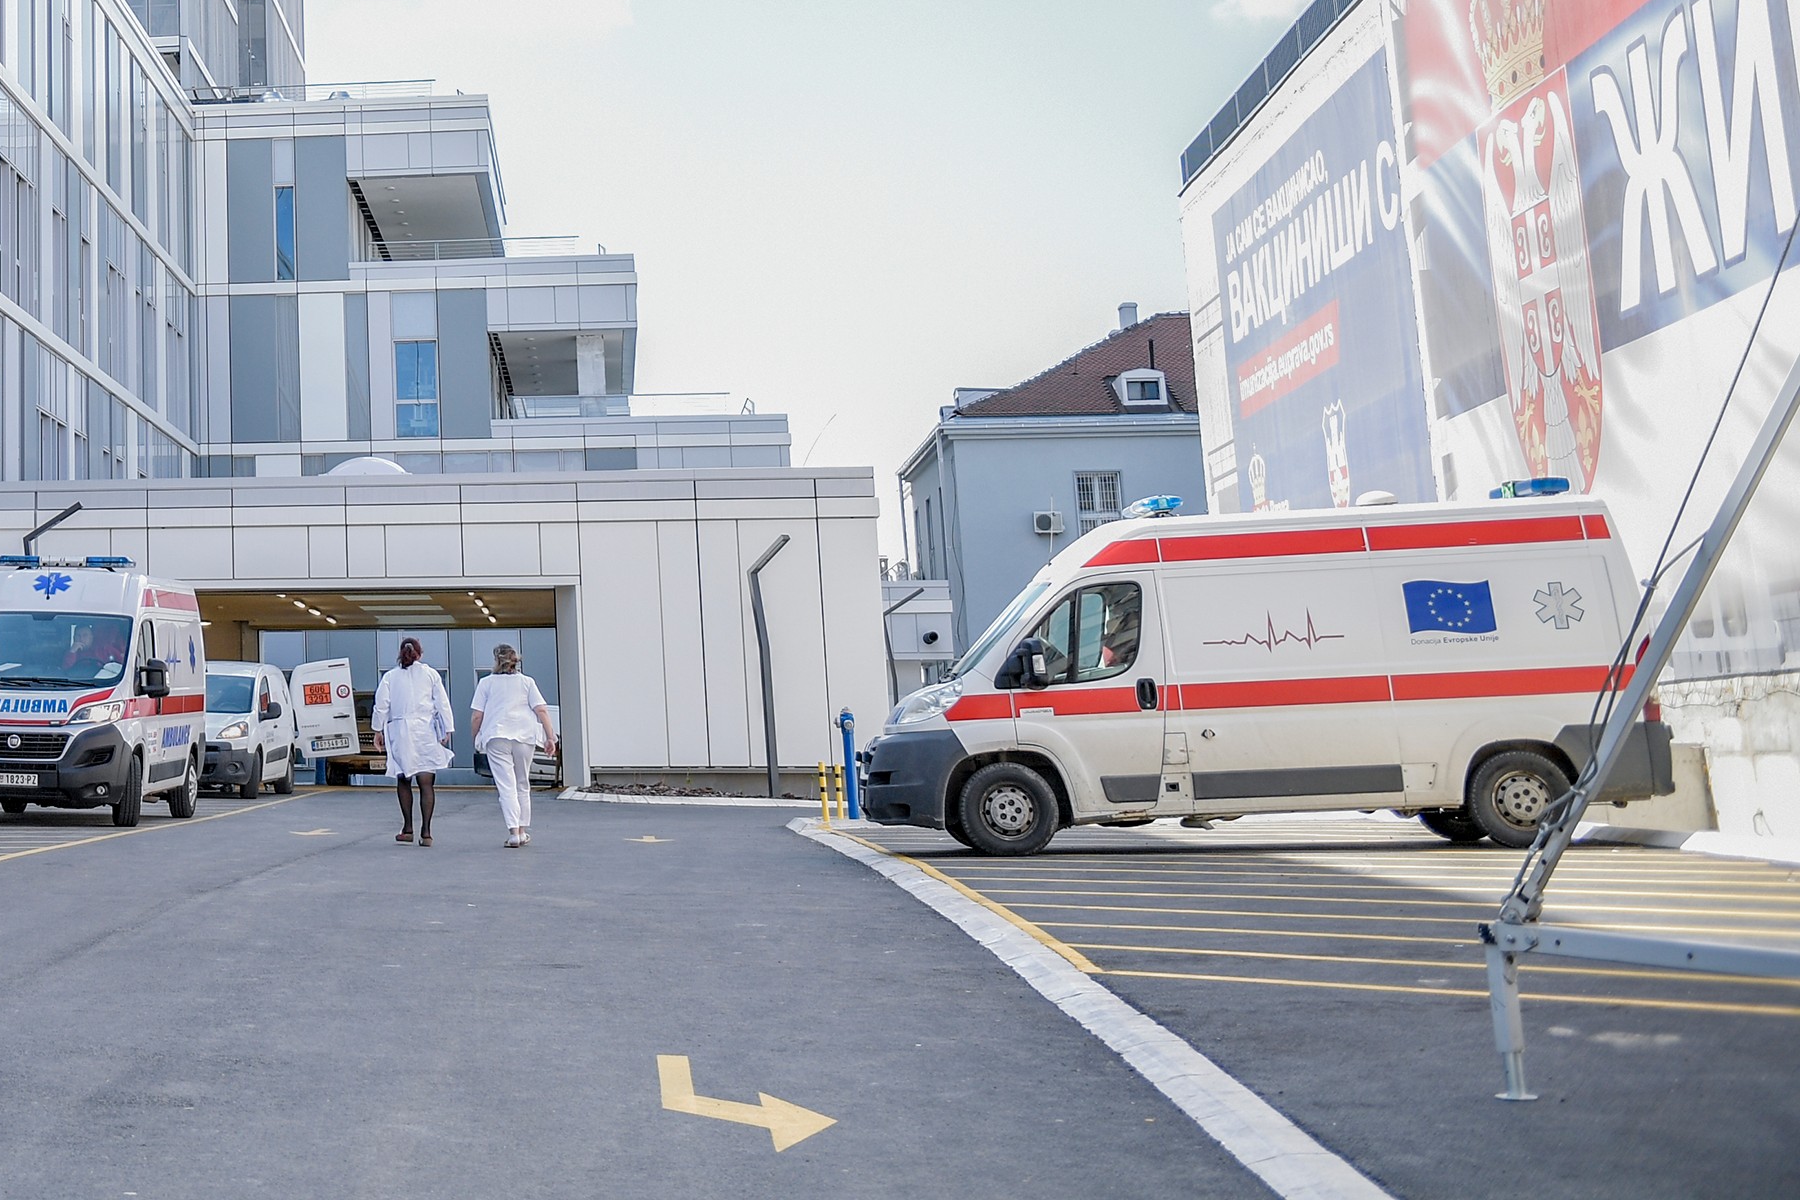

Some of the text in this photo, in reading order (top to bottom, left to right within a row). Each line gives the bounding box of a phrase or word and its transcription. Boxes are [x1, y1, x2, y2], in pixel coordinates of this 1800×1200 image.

[1227, 159, 1374, 344] ВАКЦИНИШИ
[1411, 634, 1499, 646] Donacija Evropske Unije
[162, 724, 191, 749] AMBULANCE
